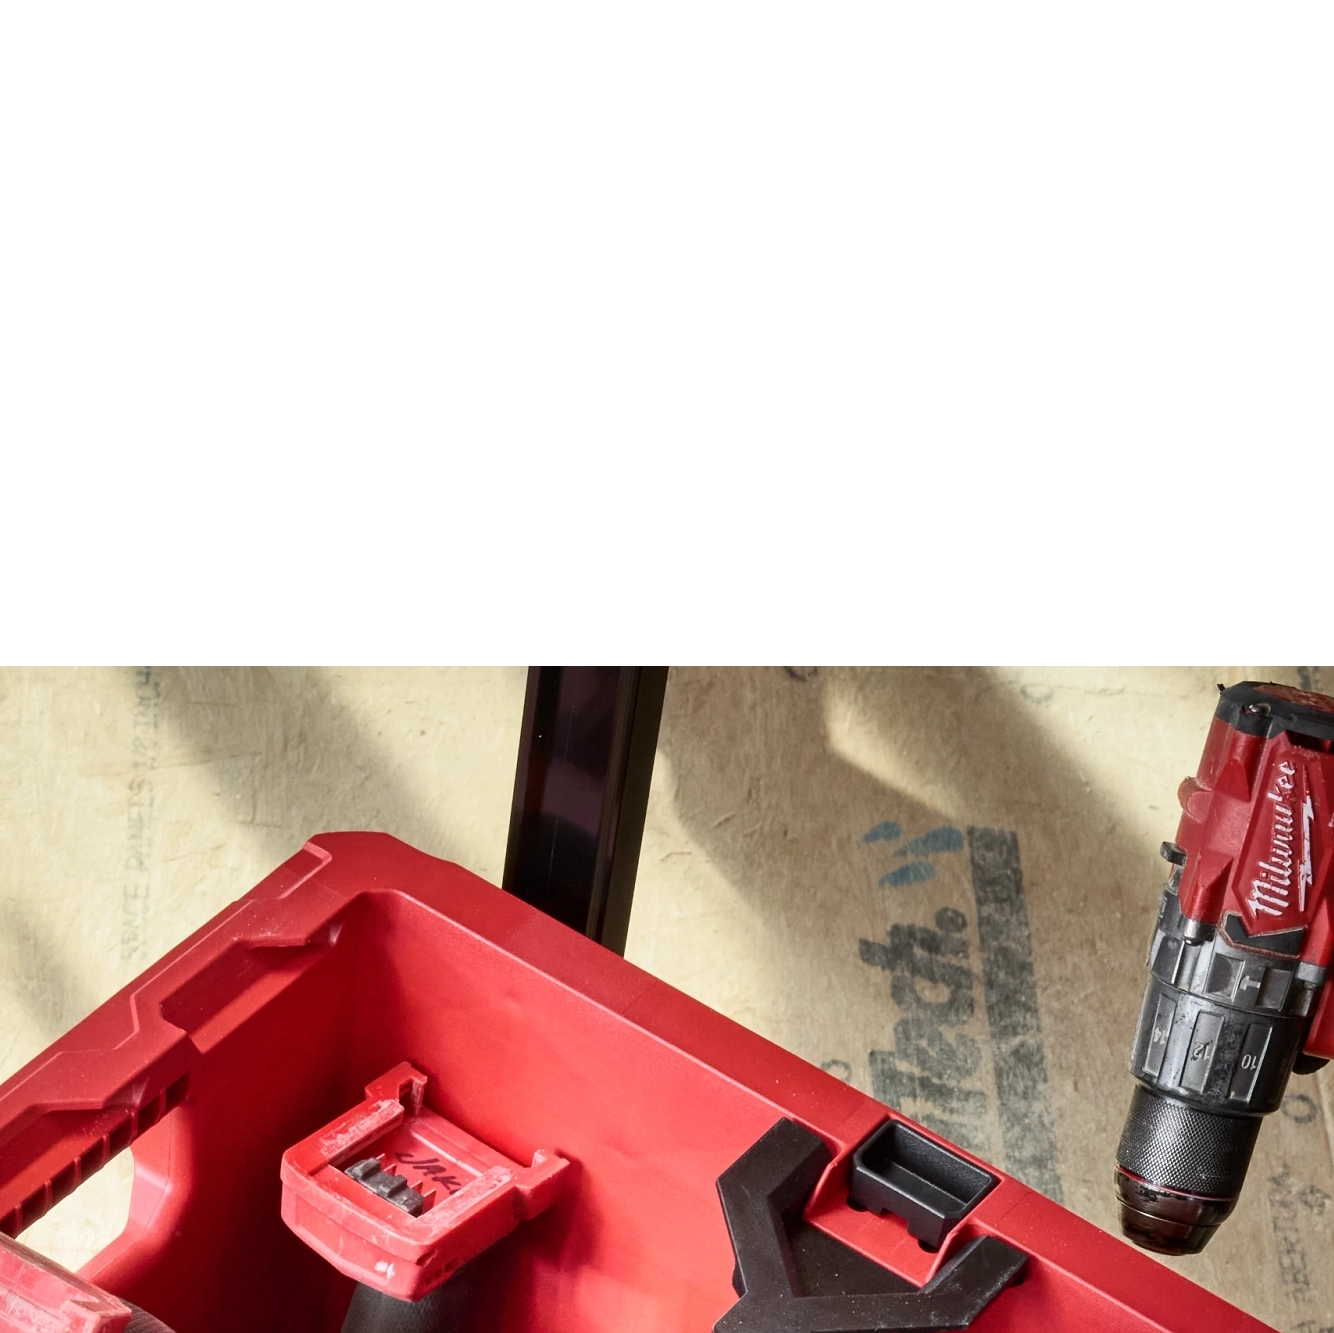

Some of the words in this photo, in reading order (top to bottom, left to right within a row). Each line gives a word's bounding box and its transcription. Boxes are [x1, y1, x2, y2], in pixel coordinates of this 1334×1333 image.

[1246, 761, 1295, 918] Milwaukee
[1154, 1026, 1169, 1045] 14
[1192, 1042, 1211, 1061] 12
[1241, 1054, 1259, 1070] 10
